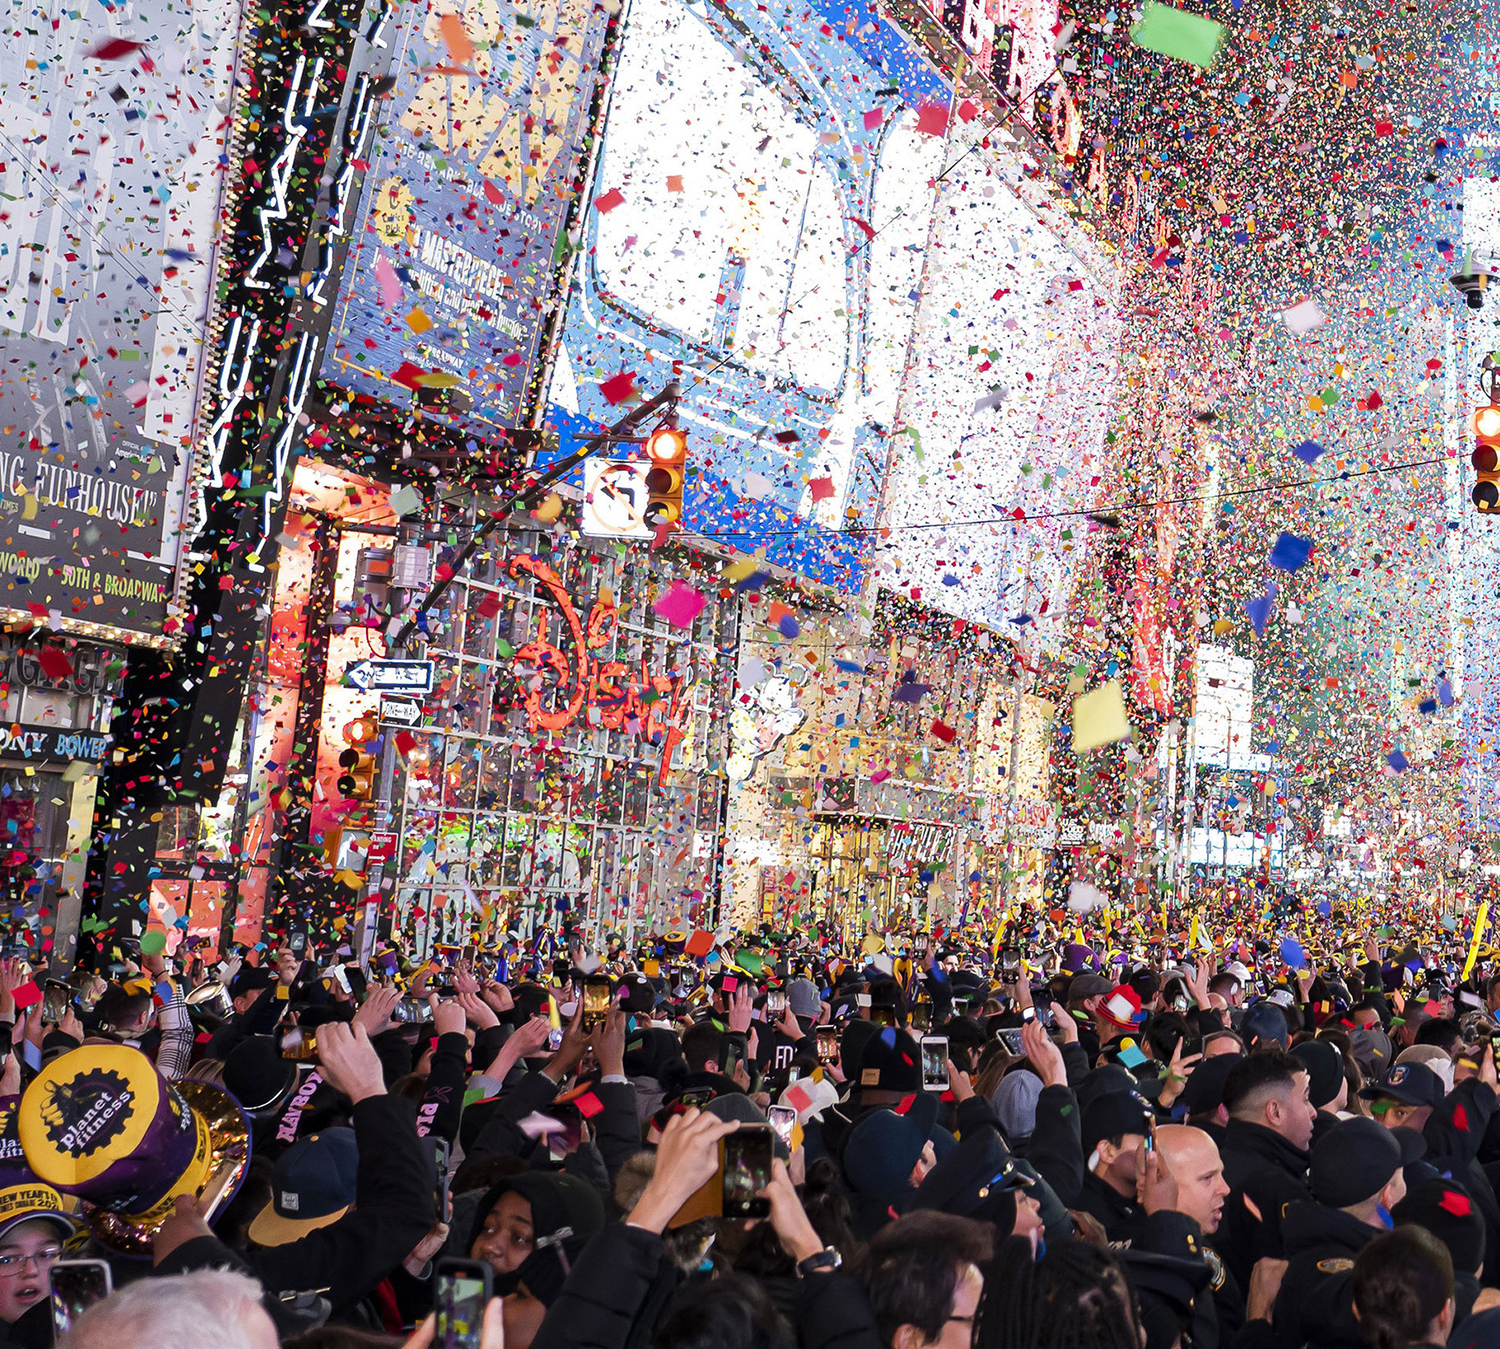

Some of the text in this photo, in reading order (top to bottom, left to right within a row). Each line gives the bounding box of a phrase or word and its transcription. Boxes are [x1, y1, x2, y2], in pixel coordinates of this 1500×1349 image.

[61, 562, 90, 591] 50TH
[58, 1091, 113, 1152] planet
[77, 1092, 134, 1156] fitness
[276, 1070, 324, 1143] PLAYBOY
